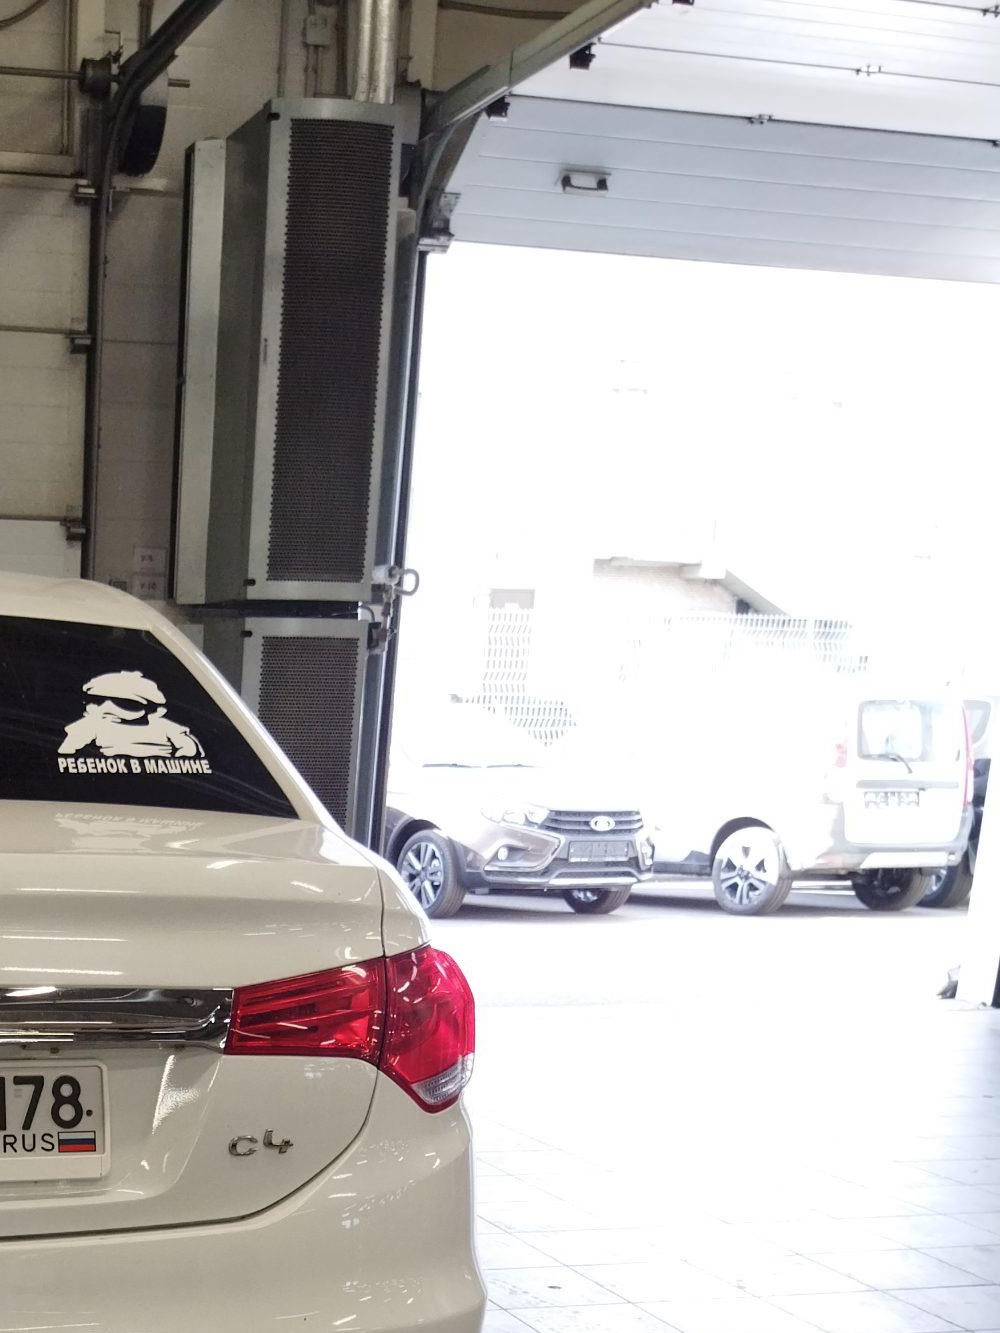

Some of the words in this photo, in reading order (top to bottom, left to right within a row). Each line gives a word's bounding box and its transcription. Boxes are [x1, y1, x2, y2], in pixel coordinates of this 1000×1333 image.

[57, 757, 128, 774] РЕБЕНОК
[130, 759, 142, 774] В
[144, 759, 212, 774] МАШИНЕ
[3, 1131, 55, 1154] RUS
[228, 1128, 294, 1156] C4
